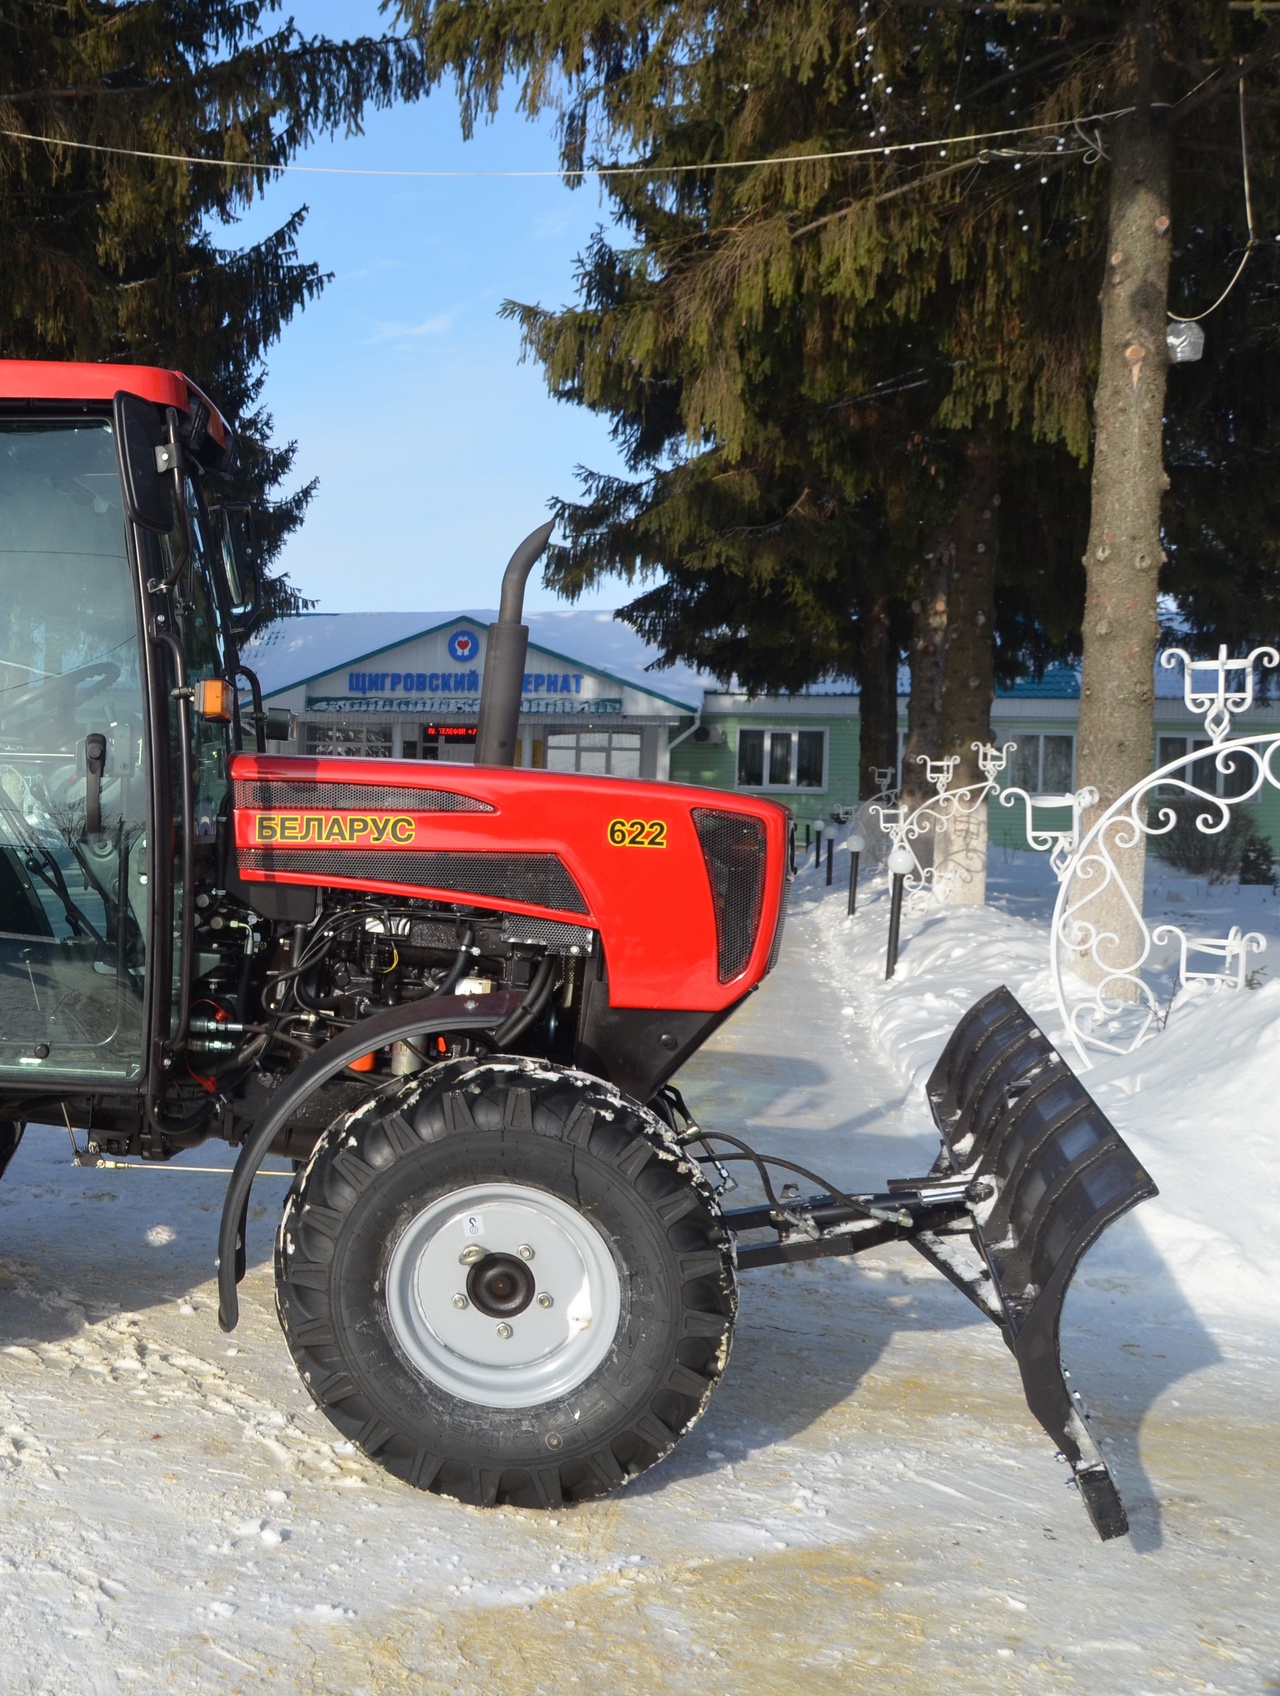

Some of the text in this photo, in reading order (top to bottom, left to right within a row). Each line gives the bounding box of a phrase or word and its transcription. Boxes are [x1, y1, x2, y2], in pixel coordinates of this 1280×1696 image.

[348, 669, 584, 694] ЩИГРОВСКИЙ ЕРНАТ
[256, 815, 416, 844] БЕЛАРУС
[608, 818, 667, 848] 622
